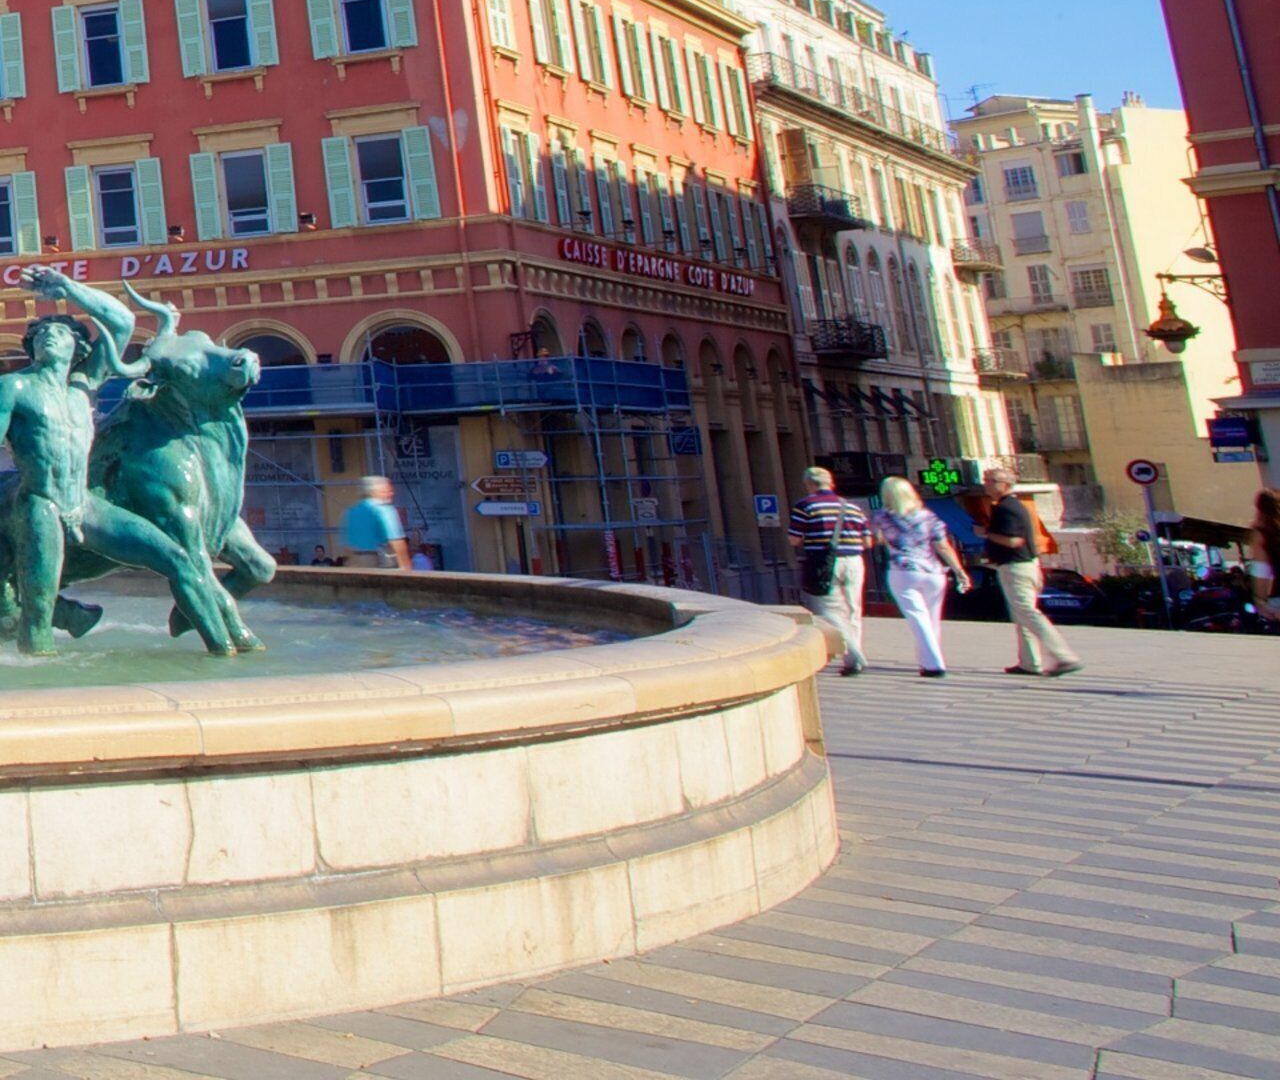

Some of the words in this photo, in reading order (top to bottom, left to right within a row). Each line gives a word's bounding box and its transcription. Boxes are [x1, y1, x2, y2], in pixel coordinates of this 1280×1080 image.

[3, 259, 88, 286] CTE
[121, 247, 250, 278] D'AZUR
[564, 238, 608, 267] CAISSE
[616, 249, 680, 281] D'EPARGNE
[688, 265, 714, 288] COTE
[721, 272, 755, 296] D'AZUR
[923, 471, 958, 484] 16:14
